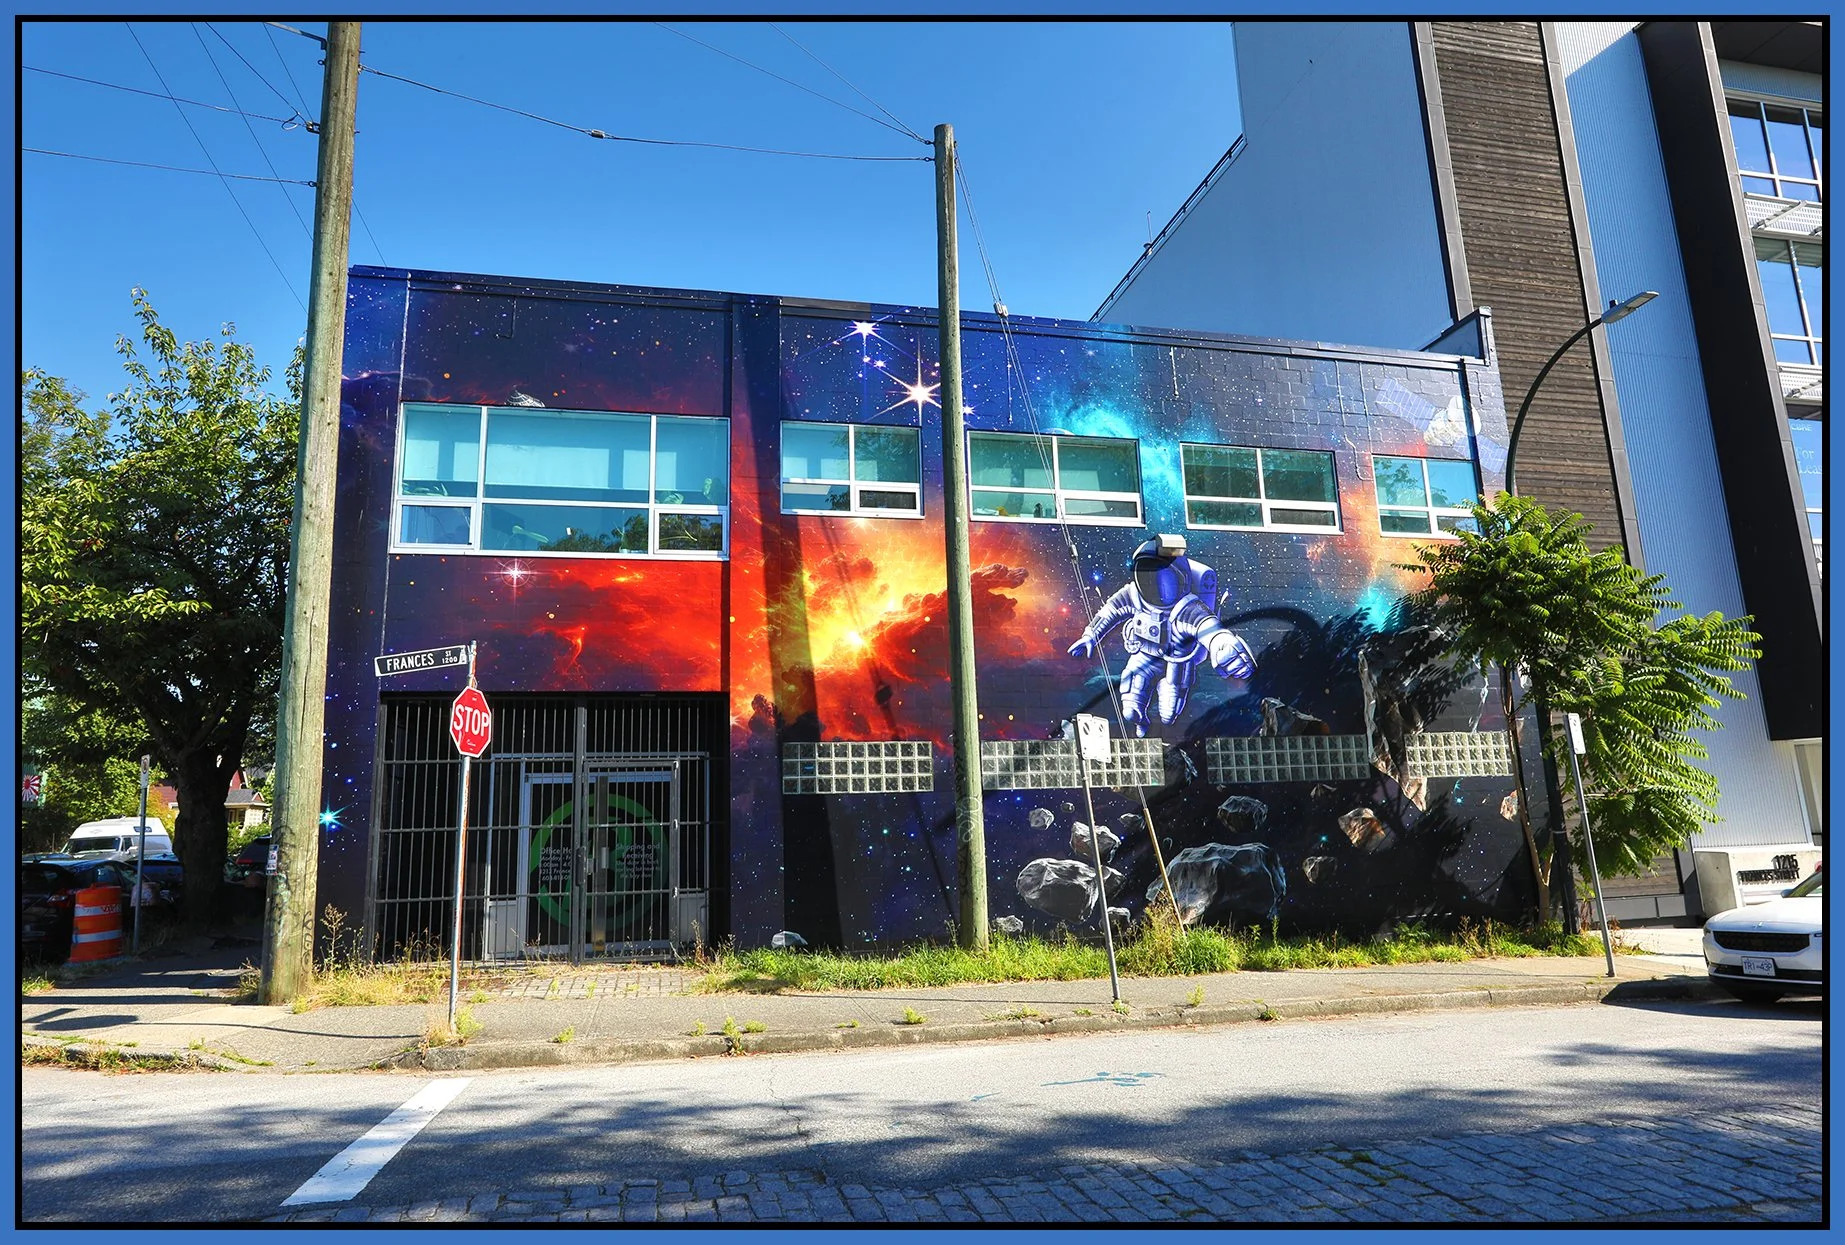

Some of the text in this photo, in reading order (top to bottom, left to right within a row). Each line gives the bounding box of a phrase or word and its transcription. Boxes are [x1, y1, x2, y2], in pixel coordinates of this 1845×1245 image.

[387, 653, 458, 671] FRANCES 1200
[453, 704, 489, 737] STOP
